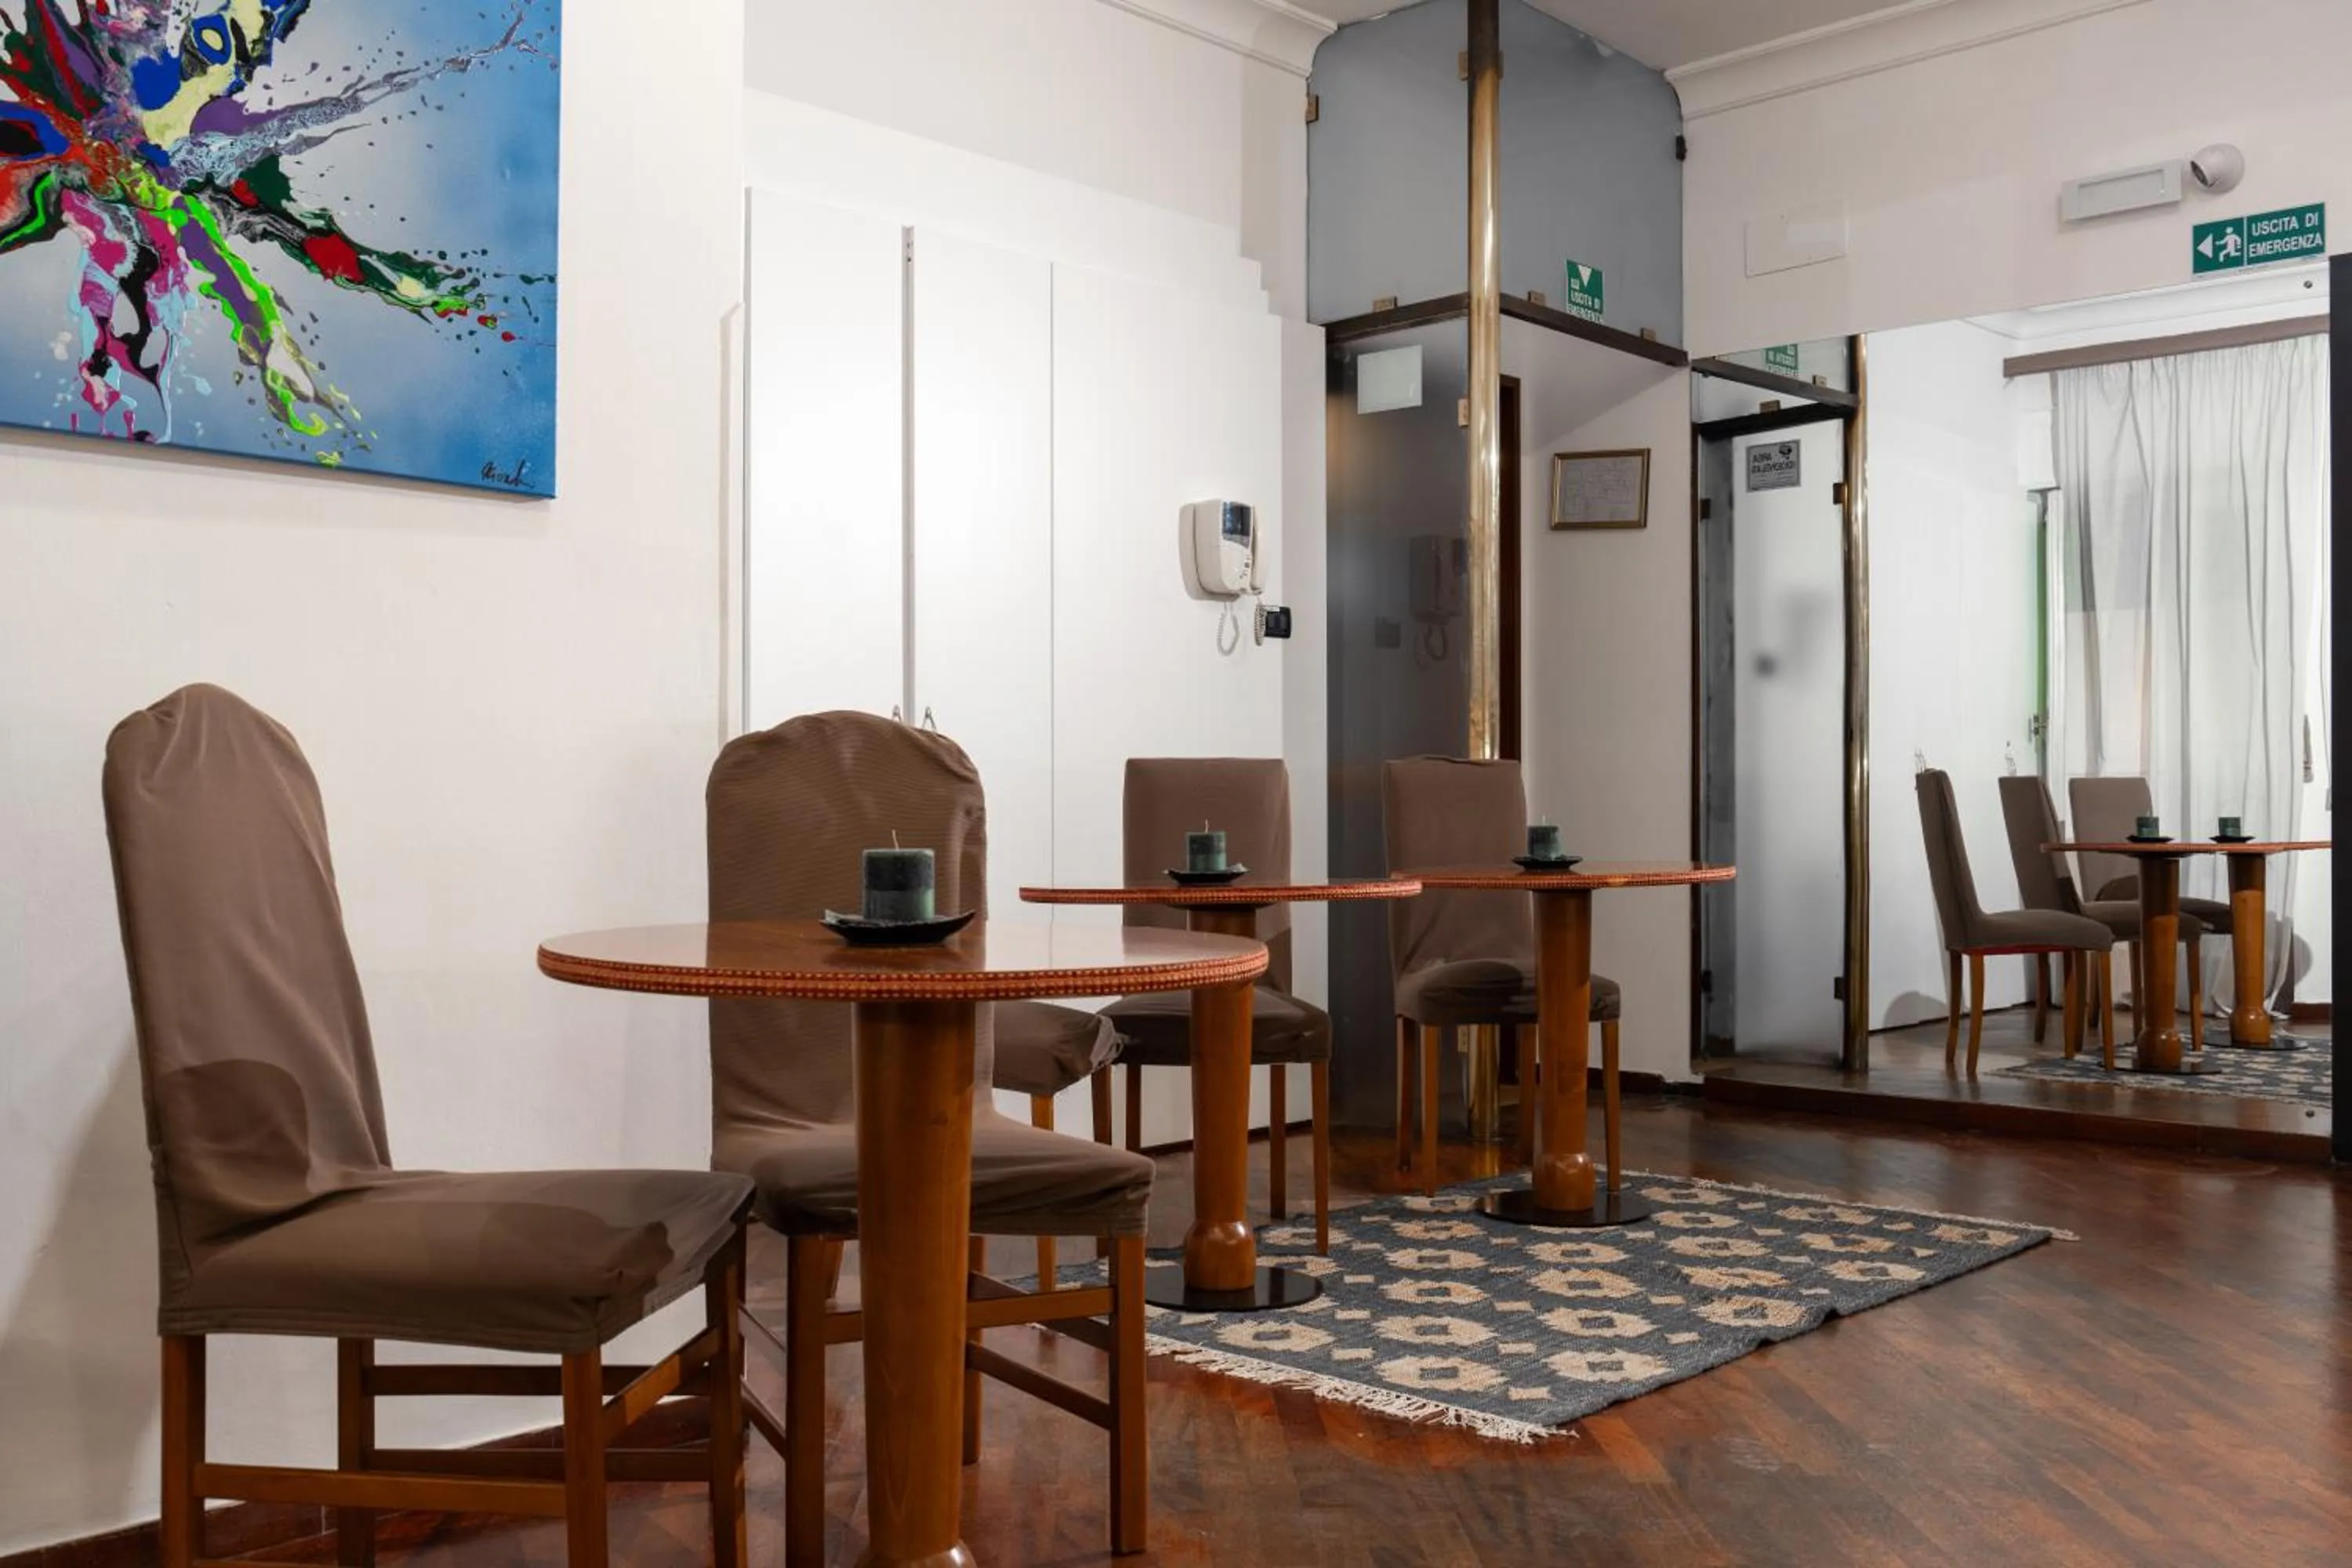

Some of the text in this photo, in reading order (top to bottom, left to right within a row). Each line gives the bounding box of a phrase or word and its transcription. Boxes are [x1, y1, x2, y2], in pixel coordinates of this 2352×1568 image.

[2252, 212, 2319, 236] USCITA DI
[2249, 232, 2323, 257] EMERGENZA
